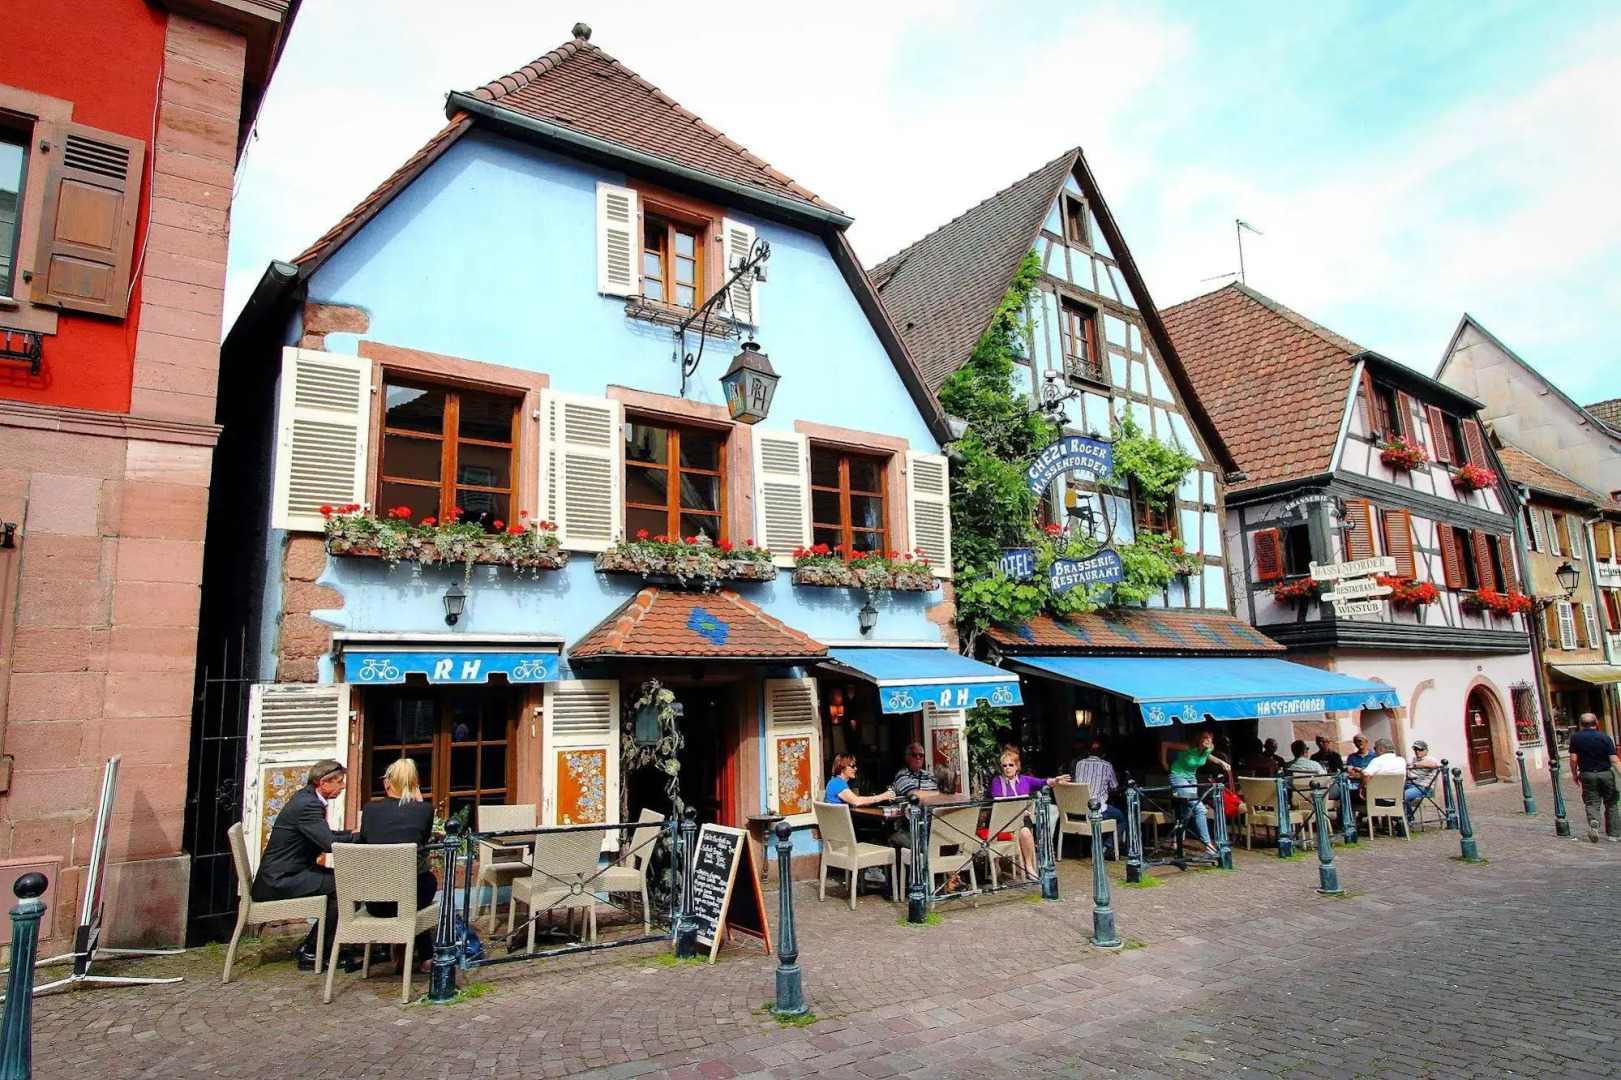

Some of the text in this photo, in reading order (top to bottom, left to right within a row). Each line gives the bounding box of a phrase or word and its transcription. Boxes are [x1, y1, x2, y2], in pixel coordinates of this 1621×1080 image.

[1028, 439, 1107, 479] CHEZ ROGER
[1031, 457, 1108, 495] HASSENFORDER
[1285, 495, 1328, 511] BRASSERIE
[1054, 555, 1116, 576] BRASSERIE
[1314, 558, 1386, 577] HASSENFORDER
[1051, 566, 1120, 590] RESTAURANT
[1336, 583, 1376, 595] RESTAURANT
[1338, 603, 1379, 614] WINSTUB
[433, 658, 481, 680] R H
[940, 688, 969, 707] R H
[1256, 699, 1325, 715] HASSENFORDER
